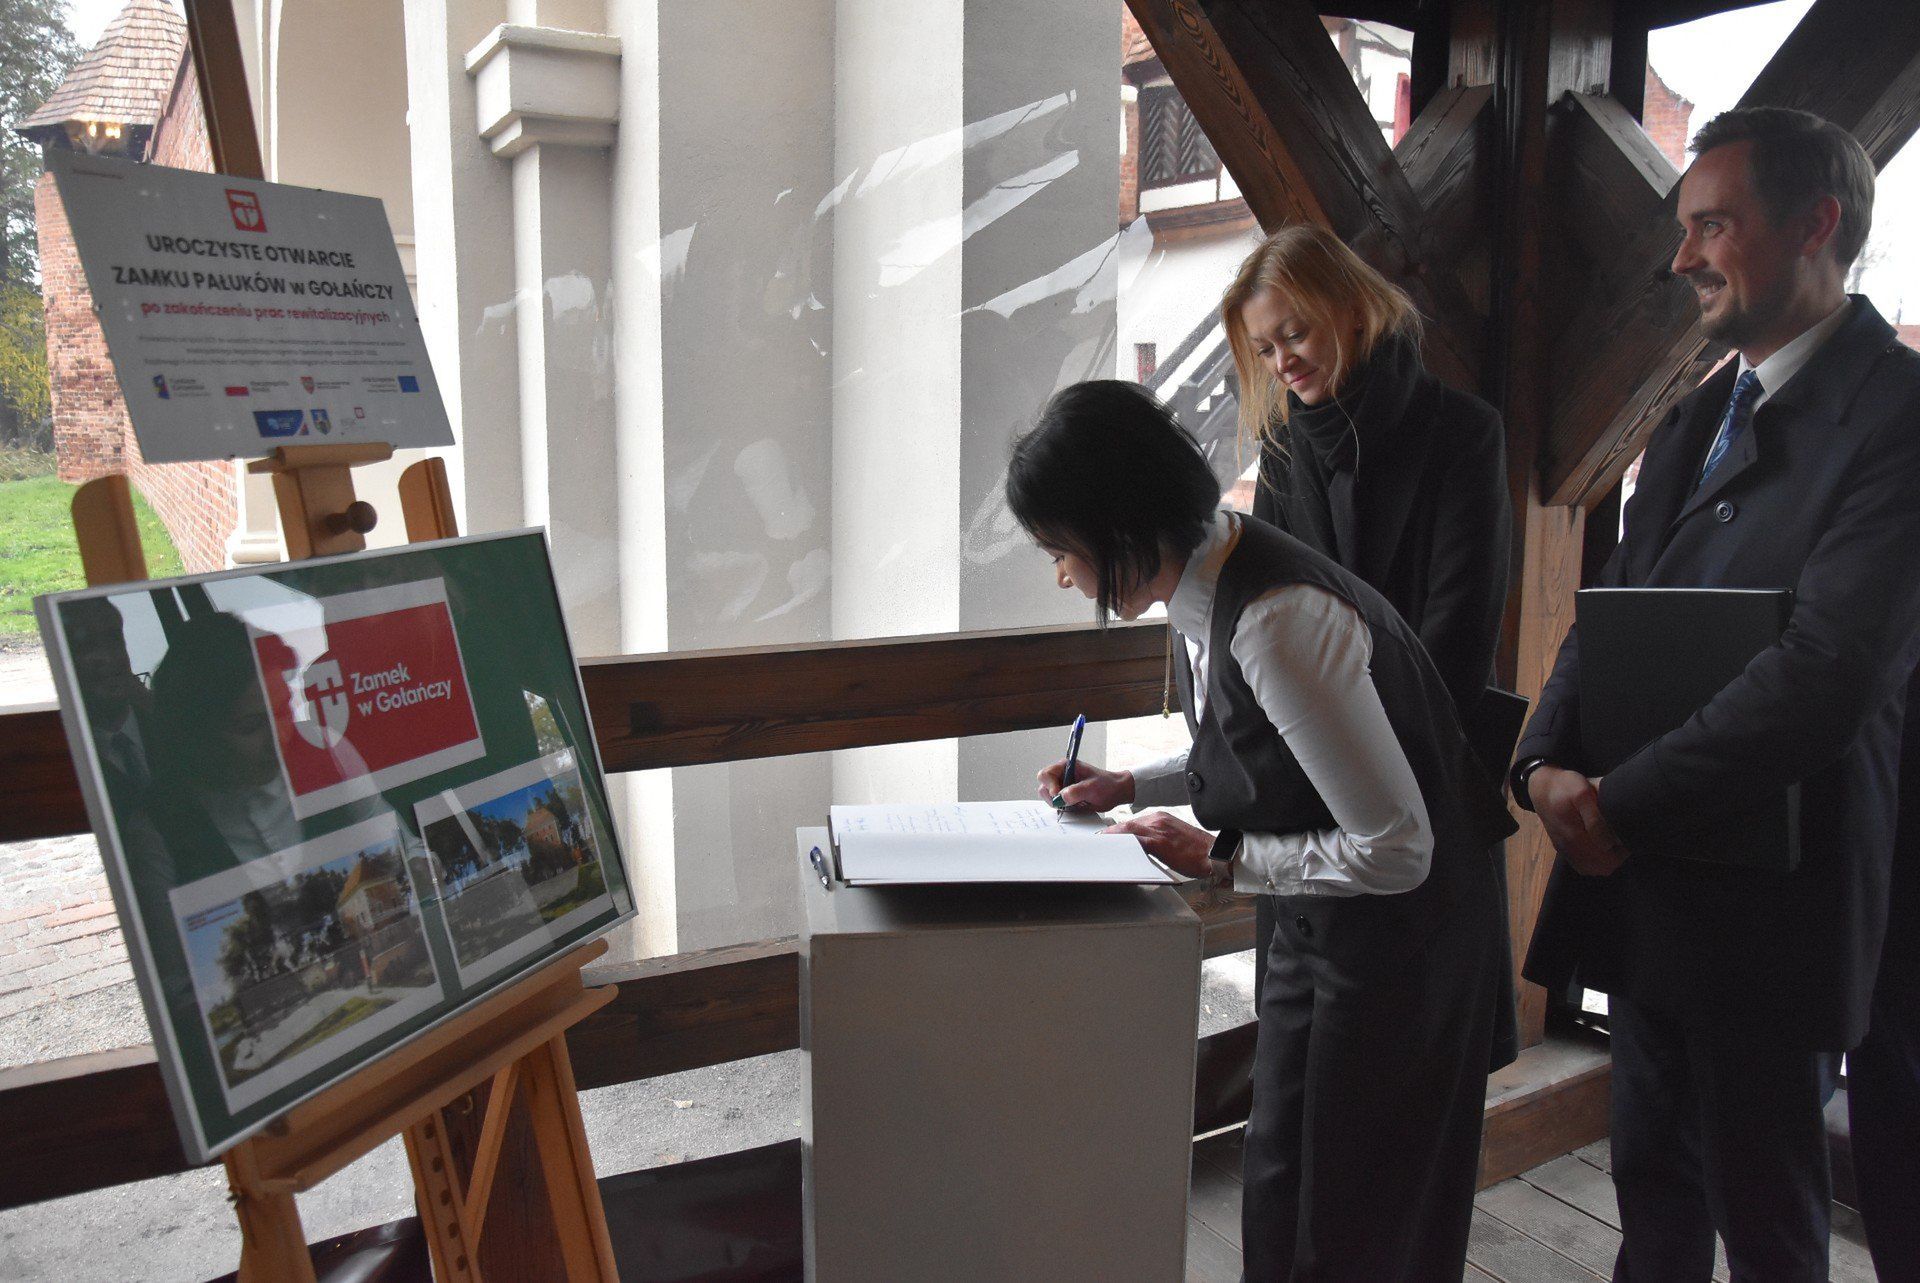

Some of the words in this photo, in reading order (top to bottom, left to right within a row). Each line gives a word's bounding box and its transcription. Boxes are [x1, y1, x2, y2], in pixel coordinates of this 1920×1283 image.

[145, 235, 263, 261] UROCZYSTE
[265, 245, 356, 269] OTWARCIE
[111, 266, 190, 288] ZAMKU
[193, 271, 286, 294] PAŁUKÓW
[308, 279, 393, 300] GOŁAŃCZY
[140, 303, 162, 319] po
[254, 307, 285, 322] prac
[287, 306, 391, 326] rewitalizacyjnych
[350, 662, 411, 695] Zamek
[357, 700, 373, 717] w
[376, 679, 452, 713] Gołańczy
